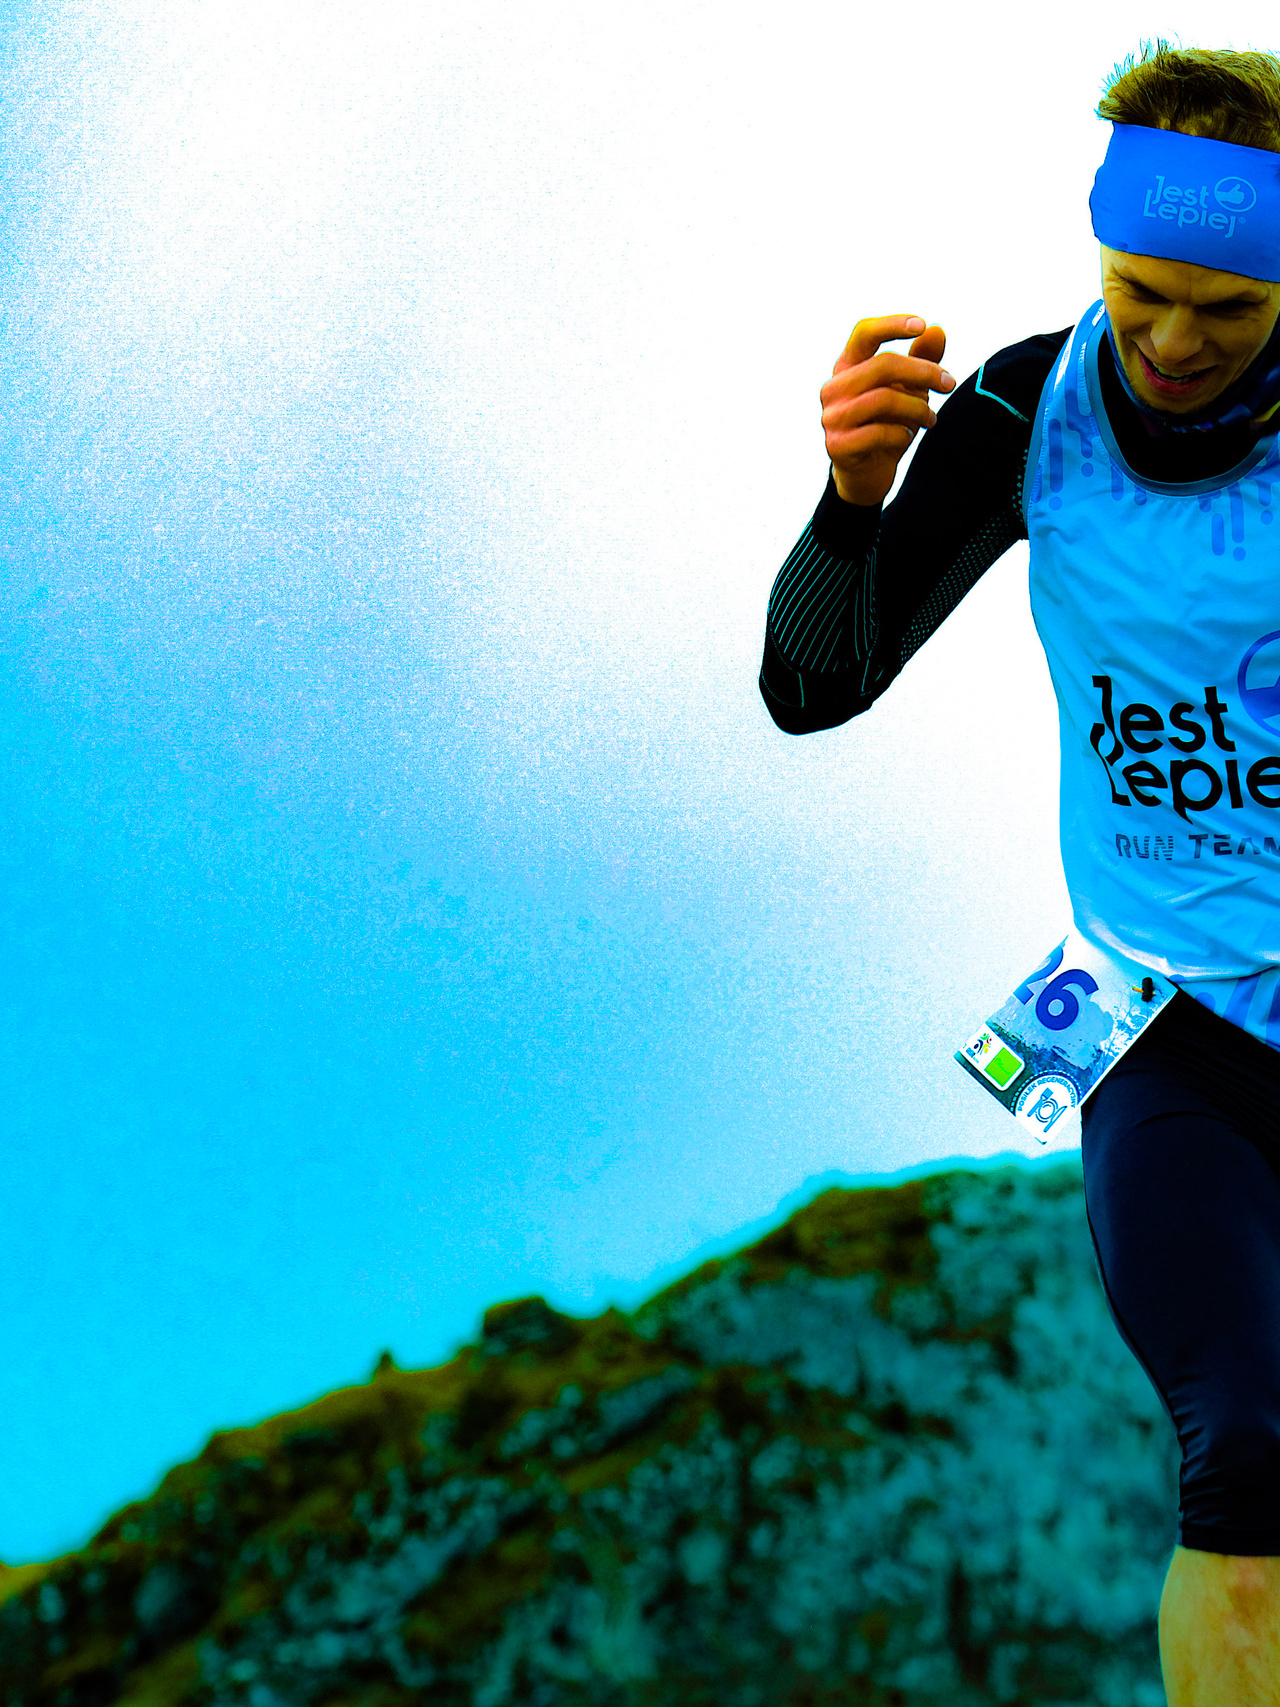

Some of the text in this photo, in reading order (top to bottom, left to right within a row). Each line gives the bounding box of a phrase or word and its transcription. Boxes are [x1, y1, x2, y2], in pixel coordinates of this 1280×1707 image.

[1152, 175, 1209, 209] Jest
[1143, 189, 1237, 238] Lepiej
[1091, 675, 1237, 767] Jest
[1115, 833, 1174, 860] RUN
